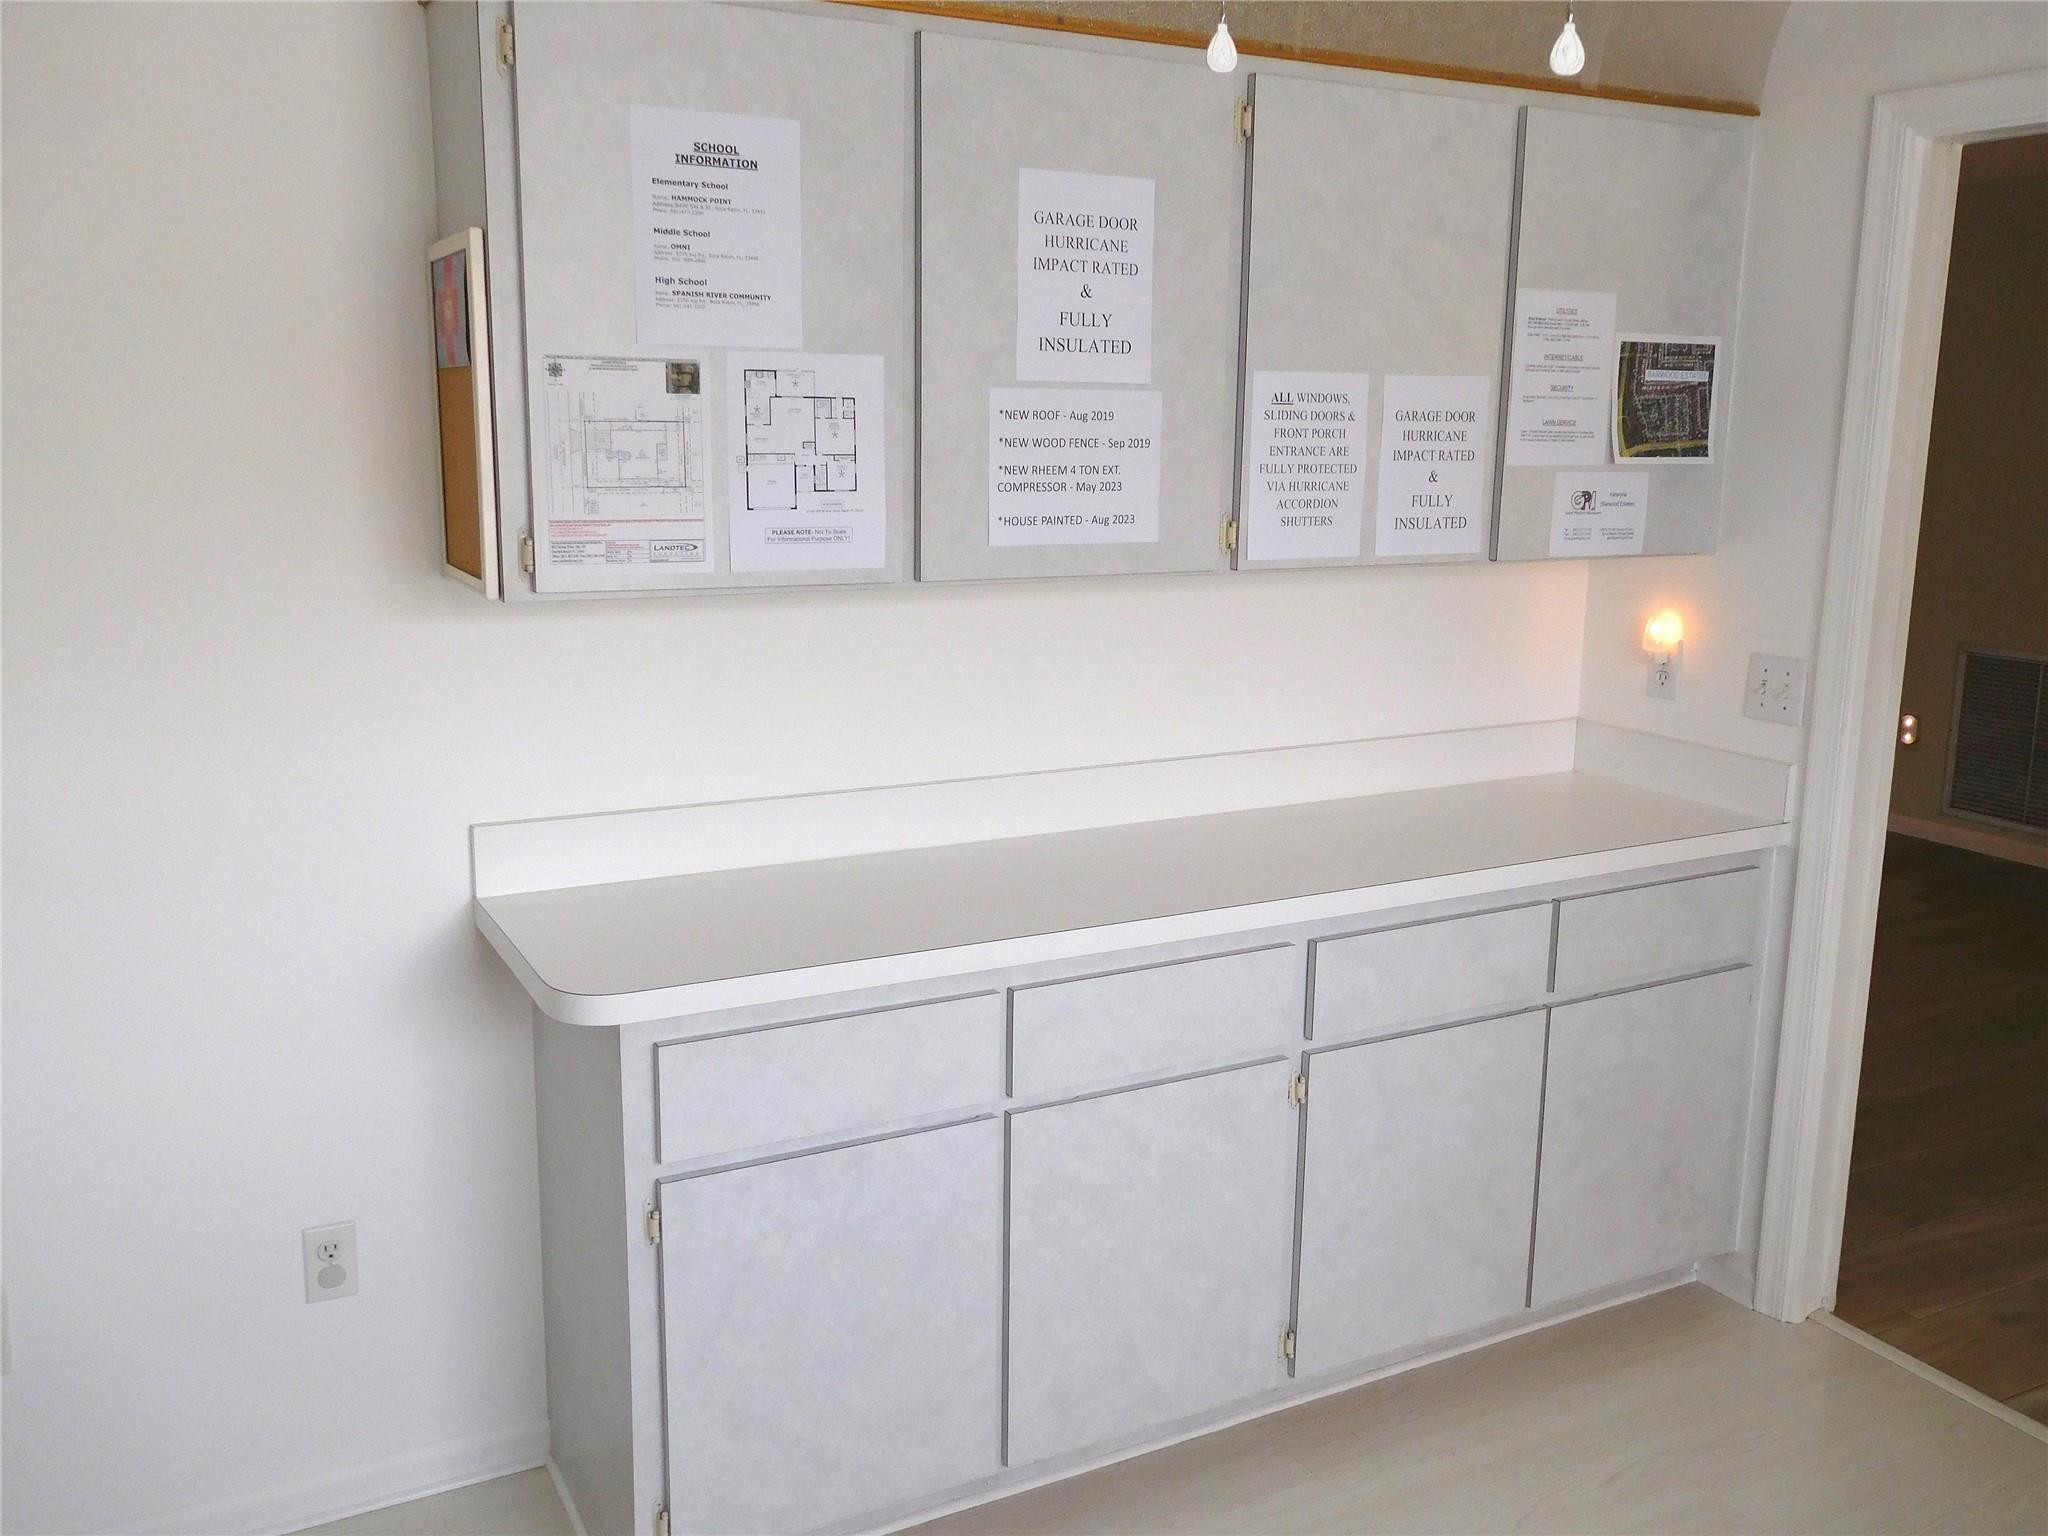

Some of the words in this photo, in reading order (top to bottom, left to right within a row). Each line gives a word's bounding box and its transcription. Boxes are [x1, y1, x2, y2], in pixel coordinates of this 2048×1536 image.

[693, 142, 740, 155] SCHOOL
[675, 153, 759, 170] INFORMATION
[651, 177, 699, 189] Elementary
[701, 181, 729, 190] School
[671, 195, 708, 203] HAMMOCK
[1033, 210, 1095, 228] GARAGE
[1099, 215, 1138, 231] DOOR
[653, 227, 681, 236] Middle
[682, 229, 711, 238] School
[670, 243, 691, 251] OMNI
[1044, 234, 1129, 253] HURRICANE
[1033, 257, 1089, 273] IMPACT
[1092, 260, 1139, 276] RATED
[655, 276, 676, 286] High
[678, 277, 708, 287] School
[671, 290, 704, 298] SPANISH
[706, 291, 728, 299] RIVER
[729, 293, 772, 301] COMMUNITY
[1080, 284, 1092, 298] &
[1059, 311, 1113, 328] FULLY
[1038, 336, 1132, 354] INSULATED
[1271, 392, 1294, 405] ALL
[1297, 392, 1351, 404] WINDOWS,
[1032, 410, 1061, 421] ROOF
[1069, 411, 1088, 423] Aug
[1090, 411, 1115, 421] 2019
[1263, 410, 1308, 421] SLIDING
[1310, 410, 1345, 421] DOORS
[1347, 412, 1356, 421] &
[1395, 409, 1442, 422] GARAGE
[1445, 410, 1476, 423] DOOR
[1274, 428, 1309, 439] FRONT
[1311, 428, 1346, 439] PORCH
[1402, 430, 1468, 442] HURRICANE
[1032, 438, 1066, 448] WOOD
[1069, 438, 1099, 448] FENCE
[1108, 438, 1125, 450] Sep
[1128, 438, 1151, 449] 2019
[1269, 446, 1326, 457] ENTRANCE
[1328, 446, 1350, 457] ARE
[1392, 449, 1435, 461] IMPACT
[1438, 450, 1475, 462] RATED
[1031, 465, 1068, 475] RHEEM
[1070, 465, 1076, 475] 4
[1079, 465, 1100, 475] TON
[1102, 465, 1121, 475] EXT.
[1259, 463, 1295, 474] FULLY
[1297, 463, 1358, 474] PROTECTED
[1428, 471, 1438, 483] &
[997, 481, 1067, 492] COMPRESSOR
[1076, 482, 1097, 494] May
[1099, 481, 1122, 492] 2023
[1266, 481, 1286, 492] VIA
[1288, 481, 1350, 492] HURRICANE
[1276, 498, 1339, 510] ACCORDION
[1411, 494, 1453, 508] FULLY
[1041, 515, 1083, 526] PAINTED
[1091, 515, 1109, 526] Aug
[1112, 514, 1135, 525] 2023
[1280, 516, 1333, 527] SHUTTERS
[1394, 516, 1467, 530] INSULATED
